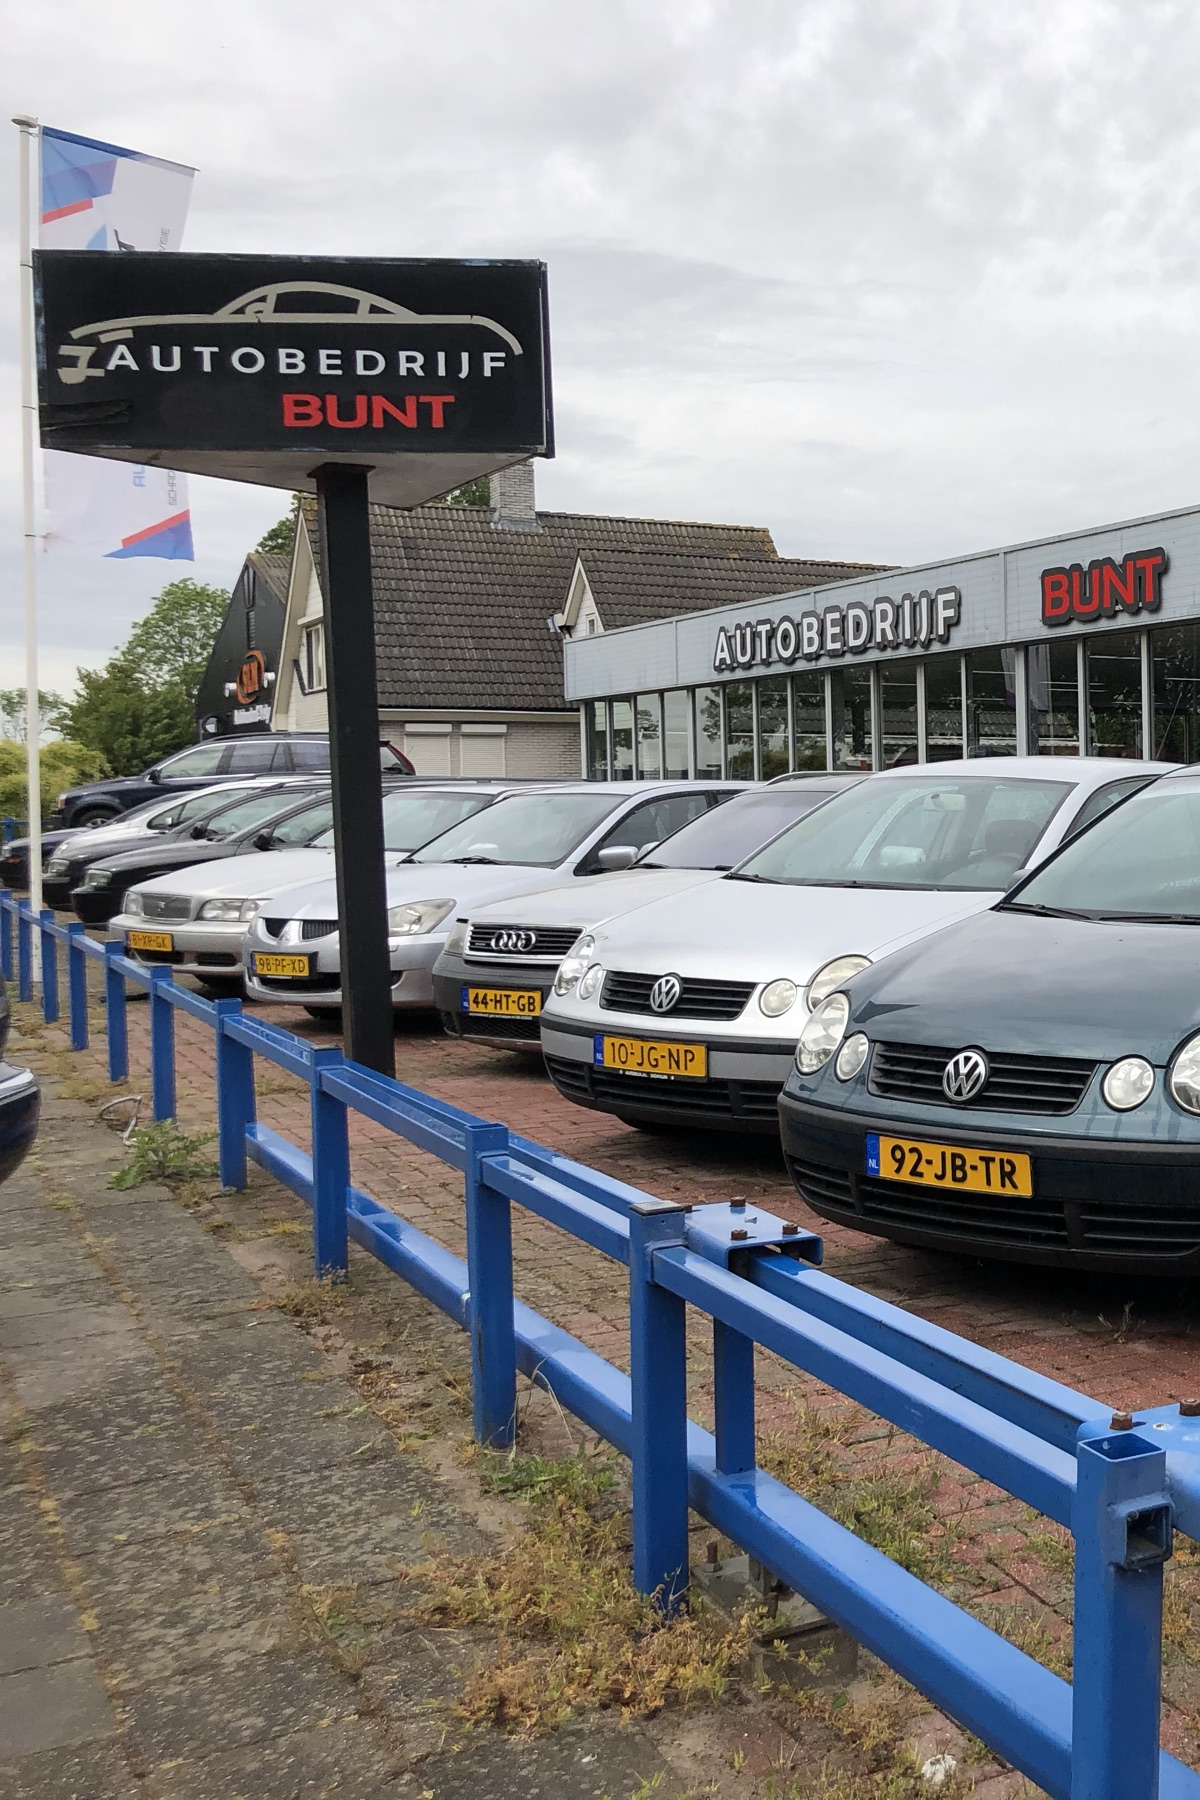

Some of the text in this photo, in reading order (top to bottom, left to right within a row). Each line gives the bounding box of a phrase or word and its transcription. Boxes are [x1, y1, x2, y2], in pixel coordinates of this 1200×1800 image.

[106, 344, 506, 379] AUTOBEDRIJF
[282, 393, 455, 428] BUNT
[714, 551, 1165, 669] AUTOBEDRIJF BUNT
[472, 992, 536, 1012] 44-HT-GB
[868, 1158, 879, 1169] NL
[890, 1143, 1019, 1190] 92-JB-TR
